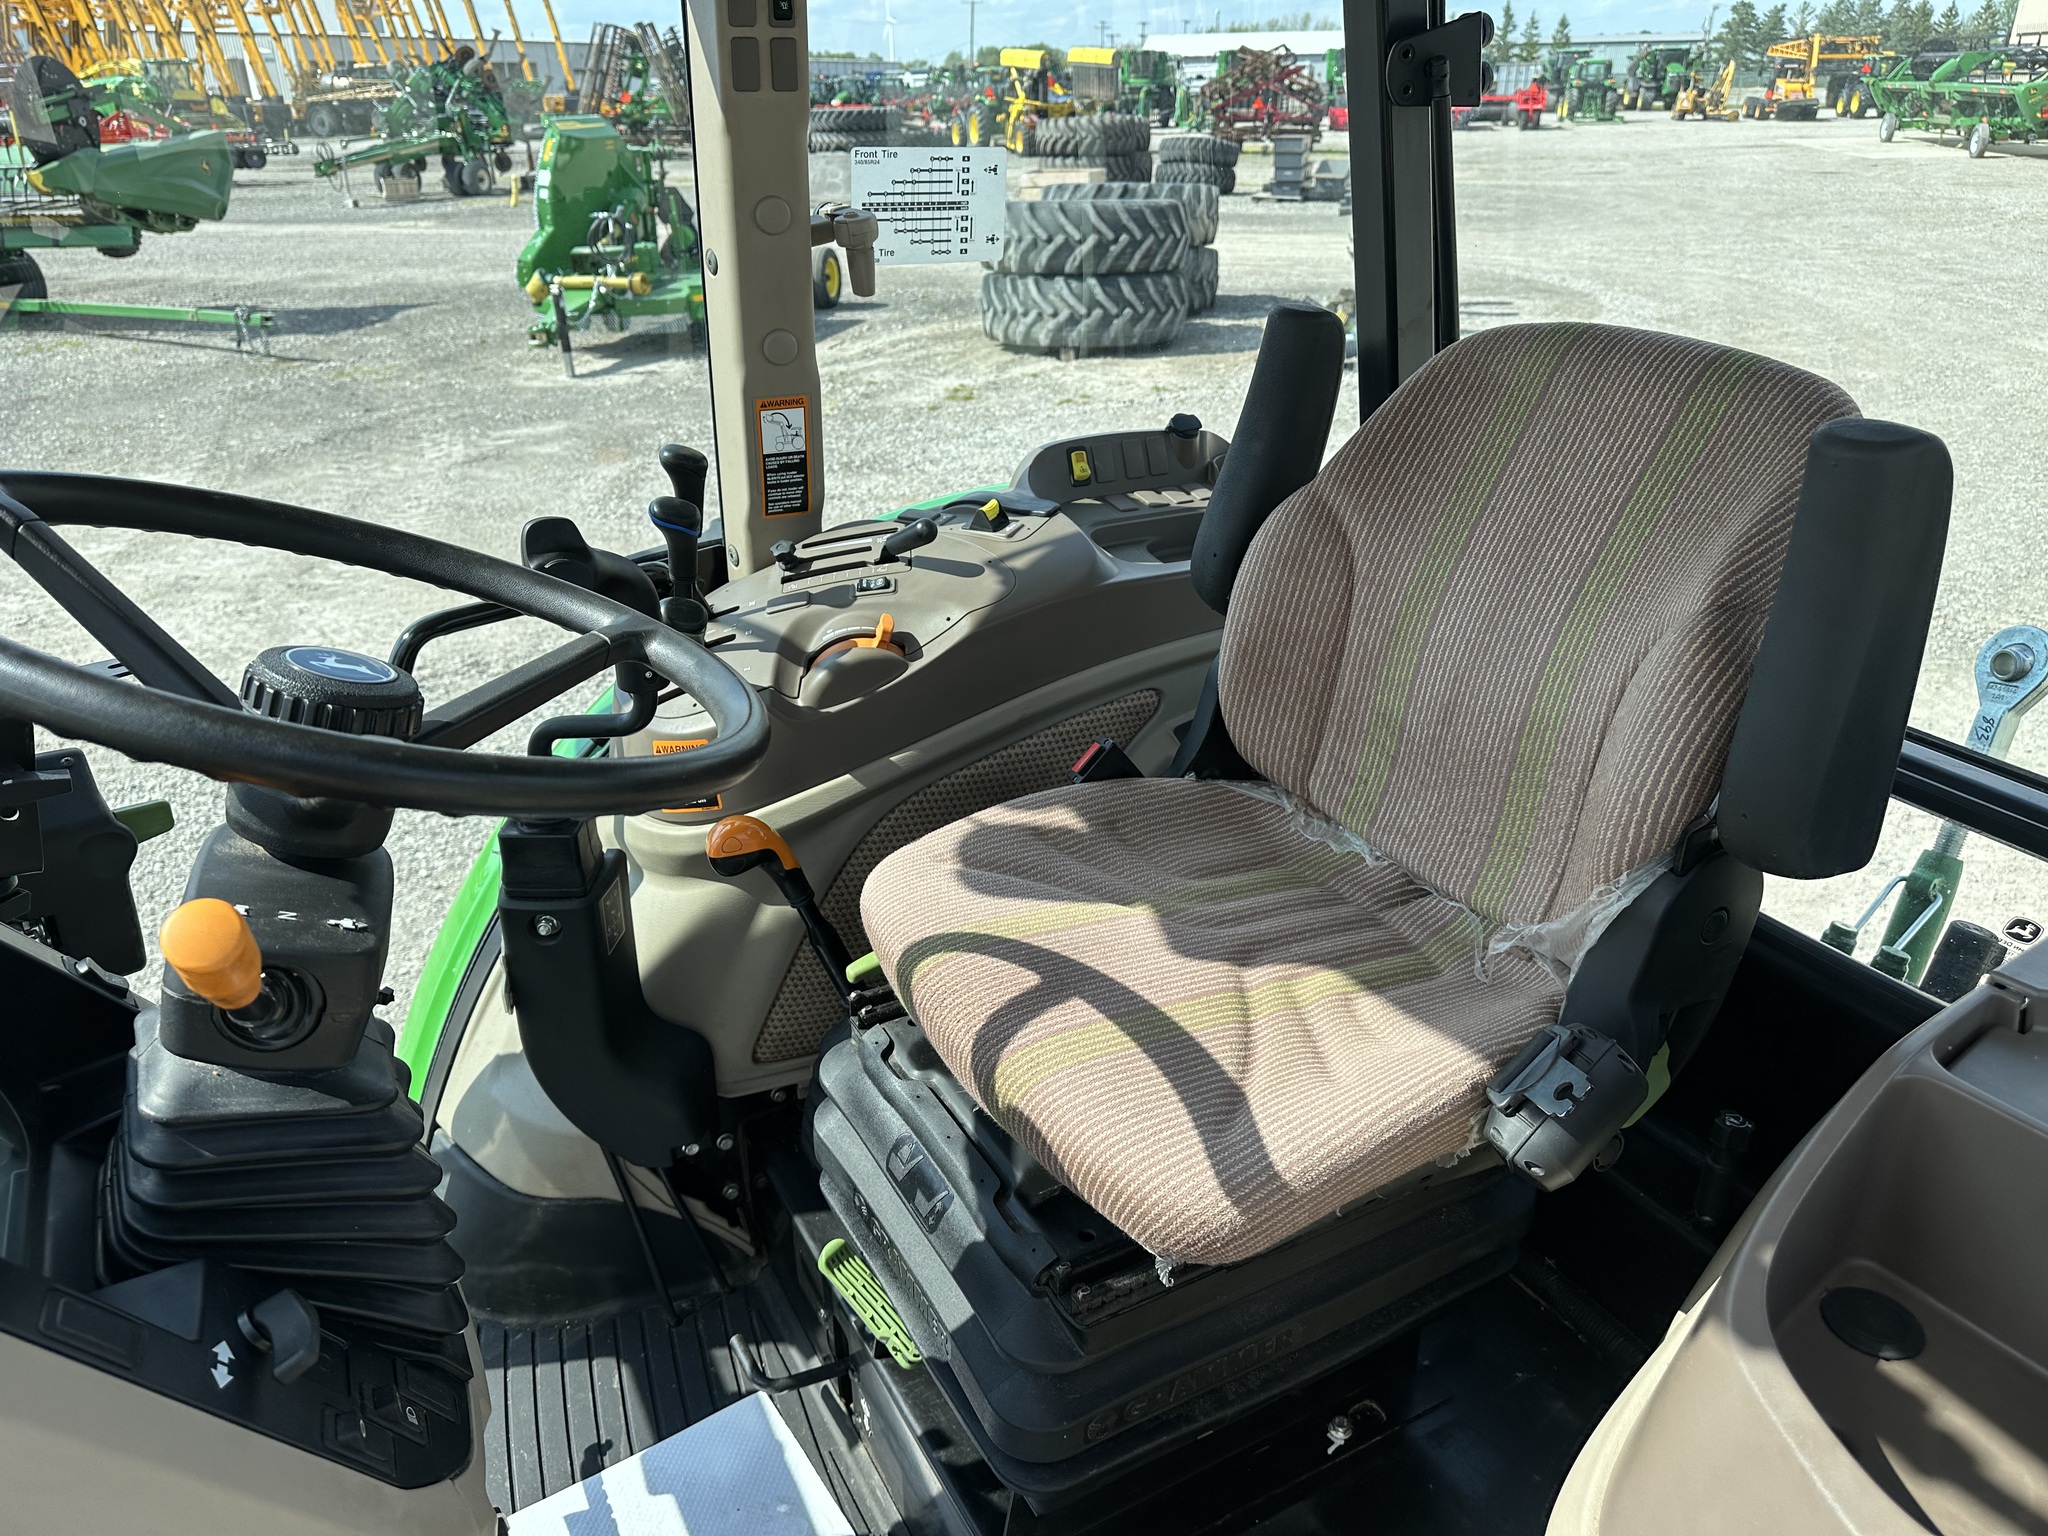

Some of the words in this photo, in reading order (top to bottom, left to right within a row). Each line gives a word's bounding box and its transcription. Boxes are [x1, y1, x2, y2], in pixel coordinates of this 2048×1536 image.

[854, 150, 878, 158] Front
[882, 150, 898, 158] Tire
[878, 248, 895, 256] Tire
[767, 398, 804, 407] WARNING
[1974, 716, 1995, 741] 893
[661, 744, 705, 754] WARNIN
